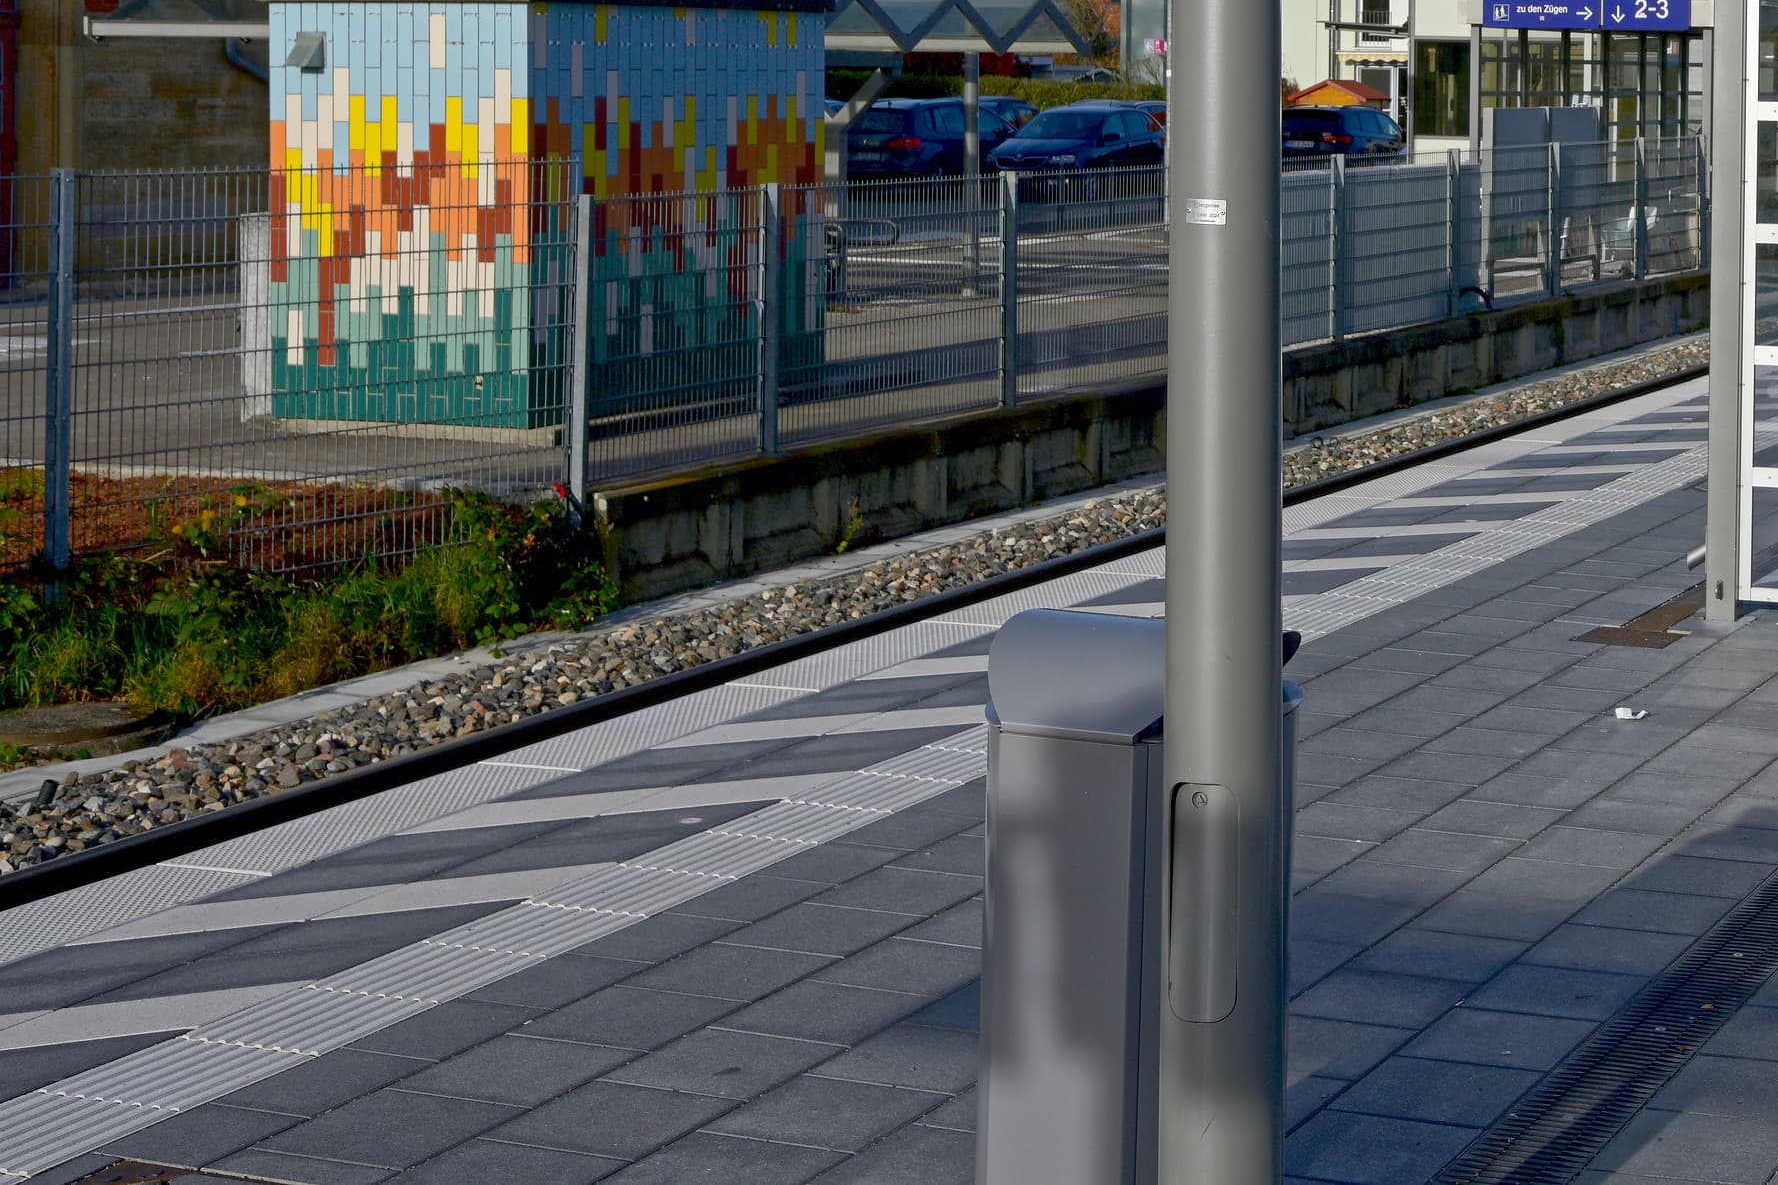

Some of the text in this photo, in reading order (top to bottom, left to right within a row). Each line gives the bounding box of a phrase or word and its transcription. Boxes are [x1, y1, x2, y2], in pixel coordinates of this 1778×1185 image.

[1516, 4, 1568, 15] zu den Zügen
